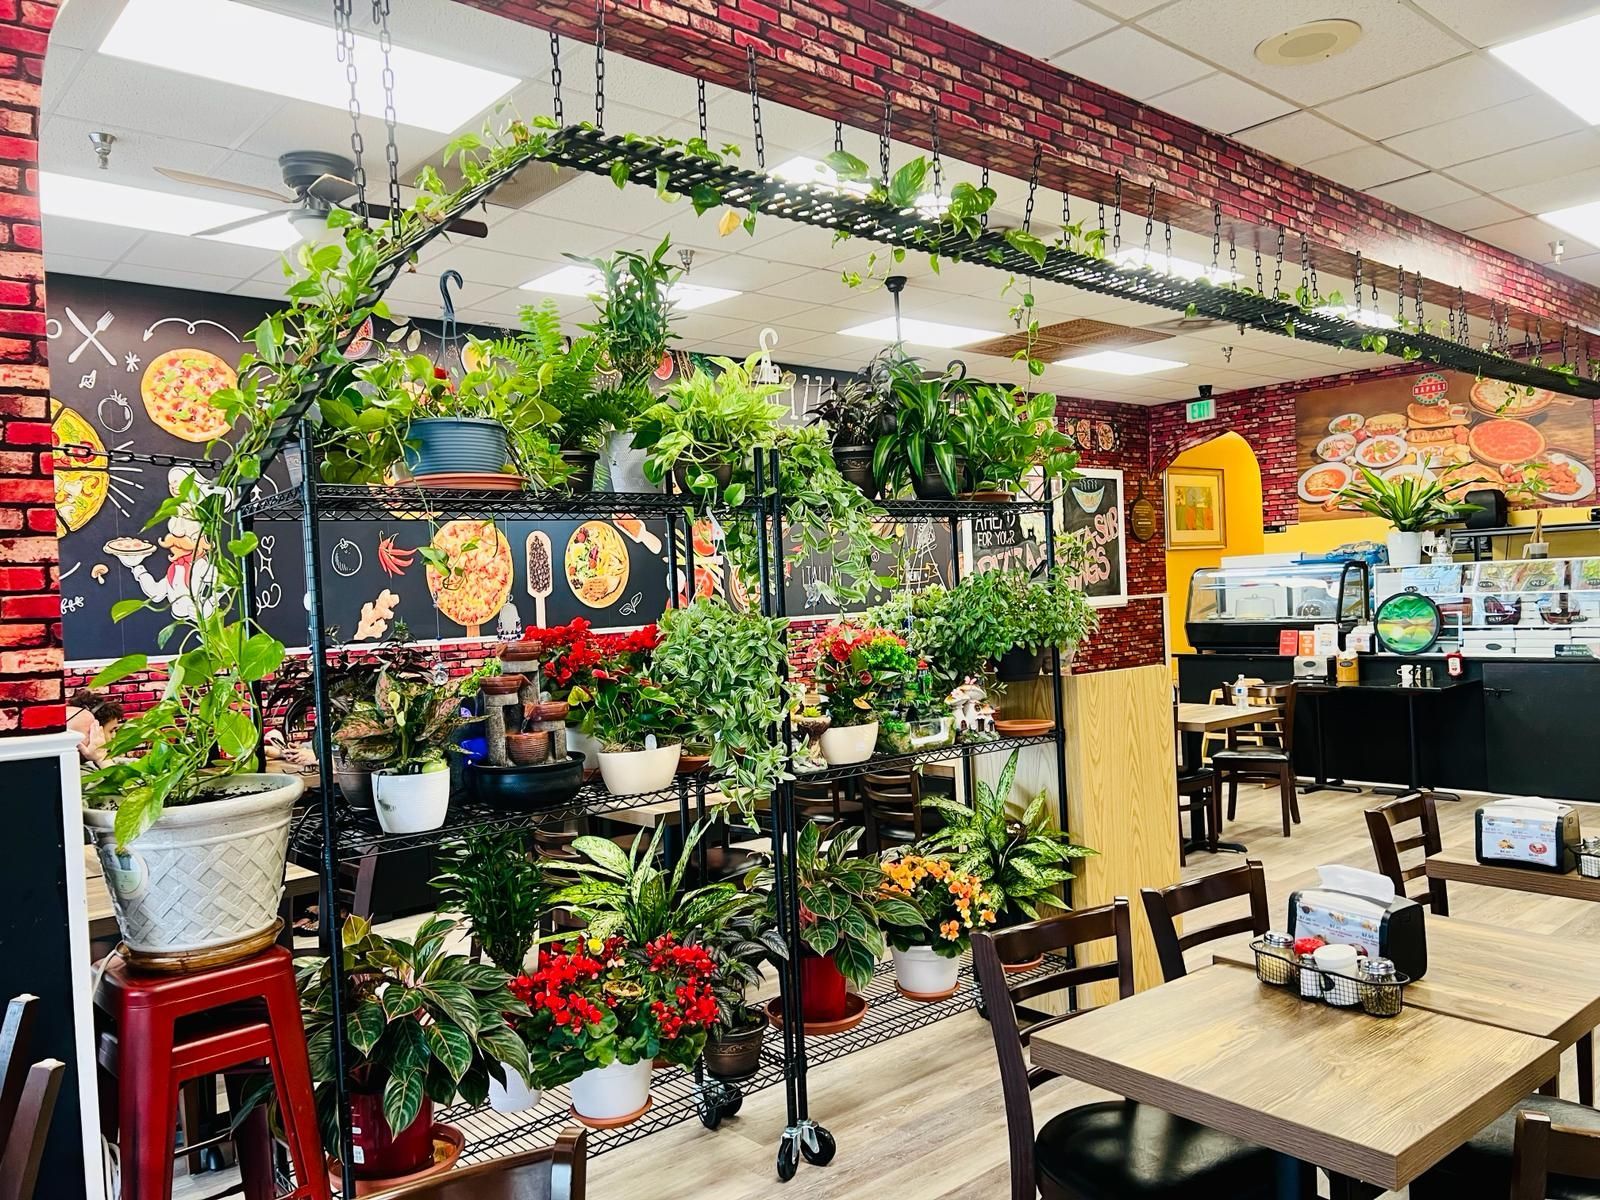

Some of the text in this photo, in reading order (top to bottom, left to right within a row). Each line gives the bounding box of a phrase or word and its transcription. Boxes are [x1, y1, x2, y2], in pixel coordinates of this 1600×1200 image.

[1414, 383, 1446, 394] NAPOLI
[1191, 402, 1210, 420] EXIT
[977, 531, 993, 547] FOR
